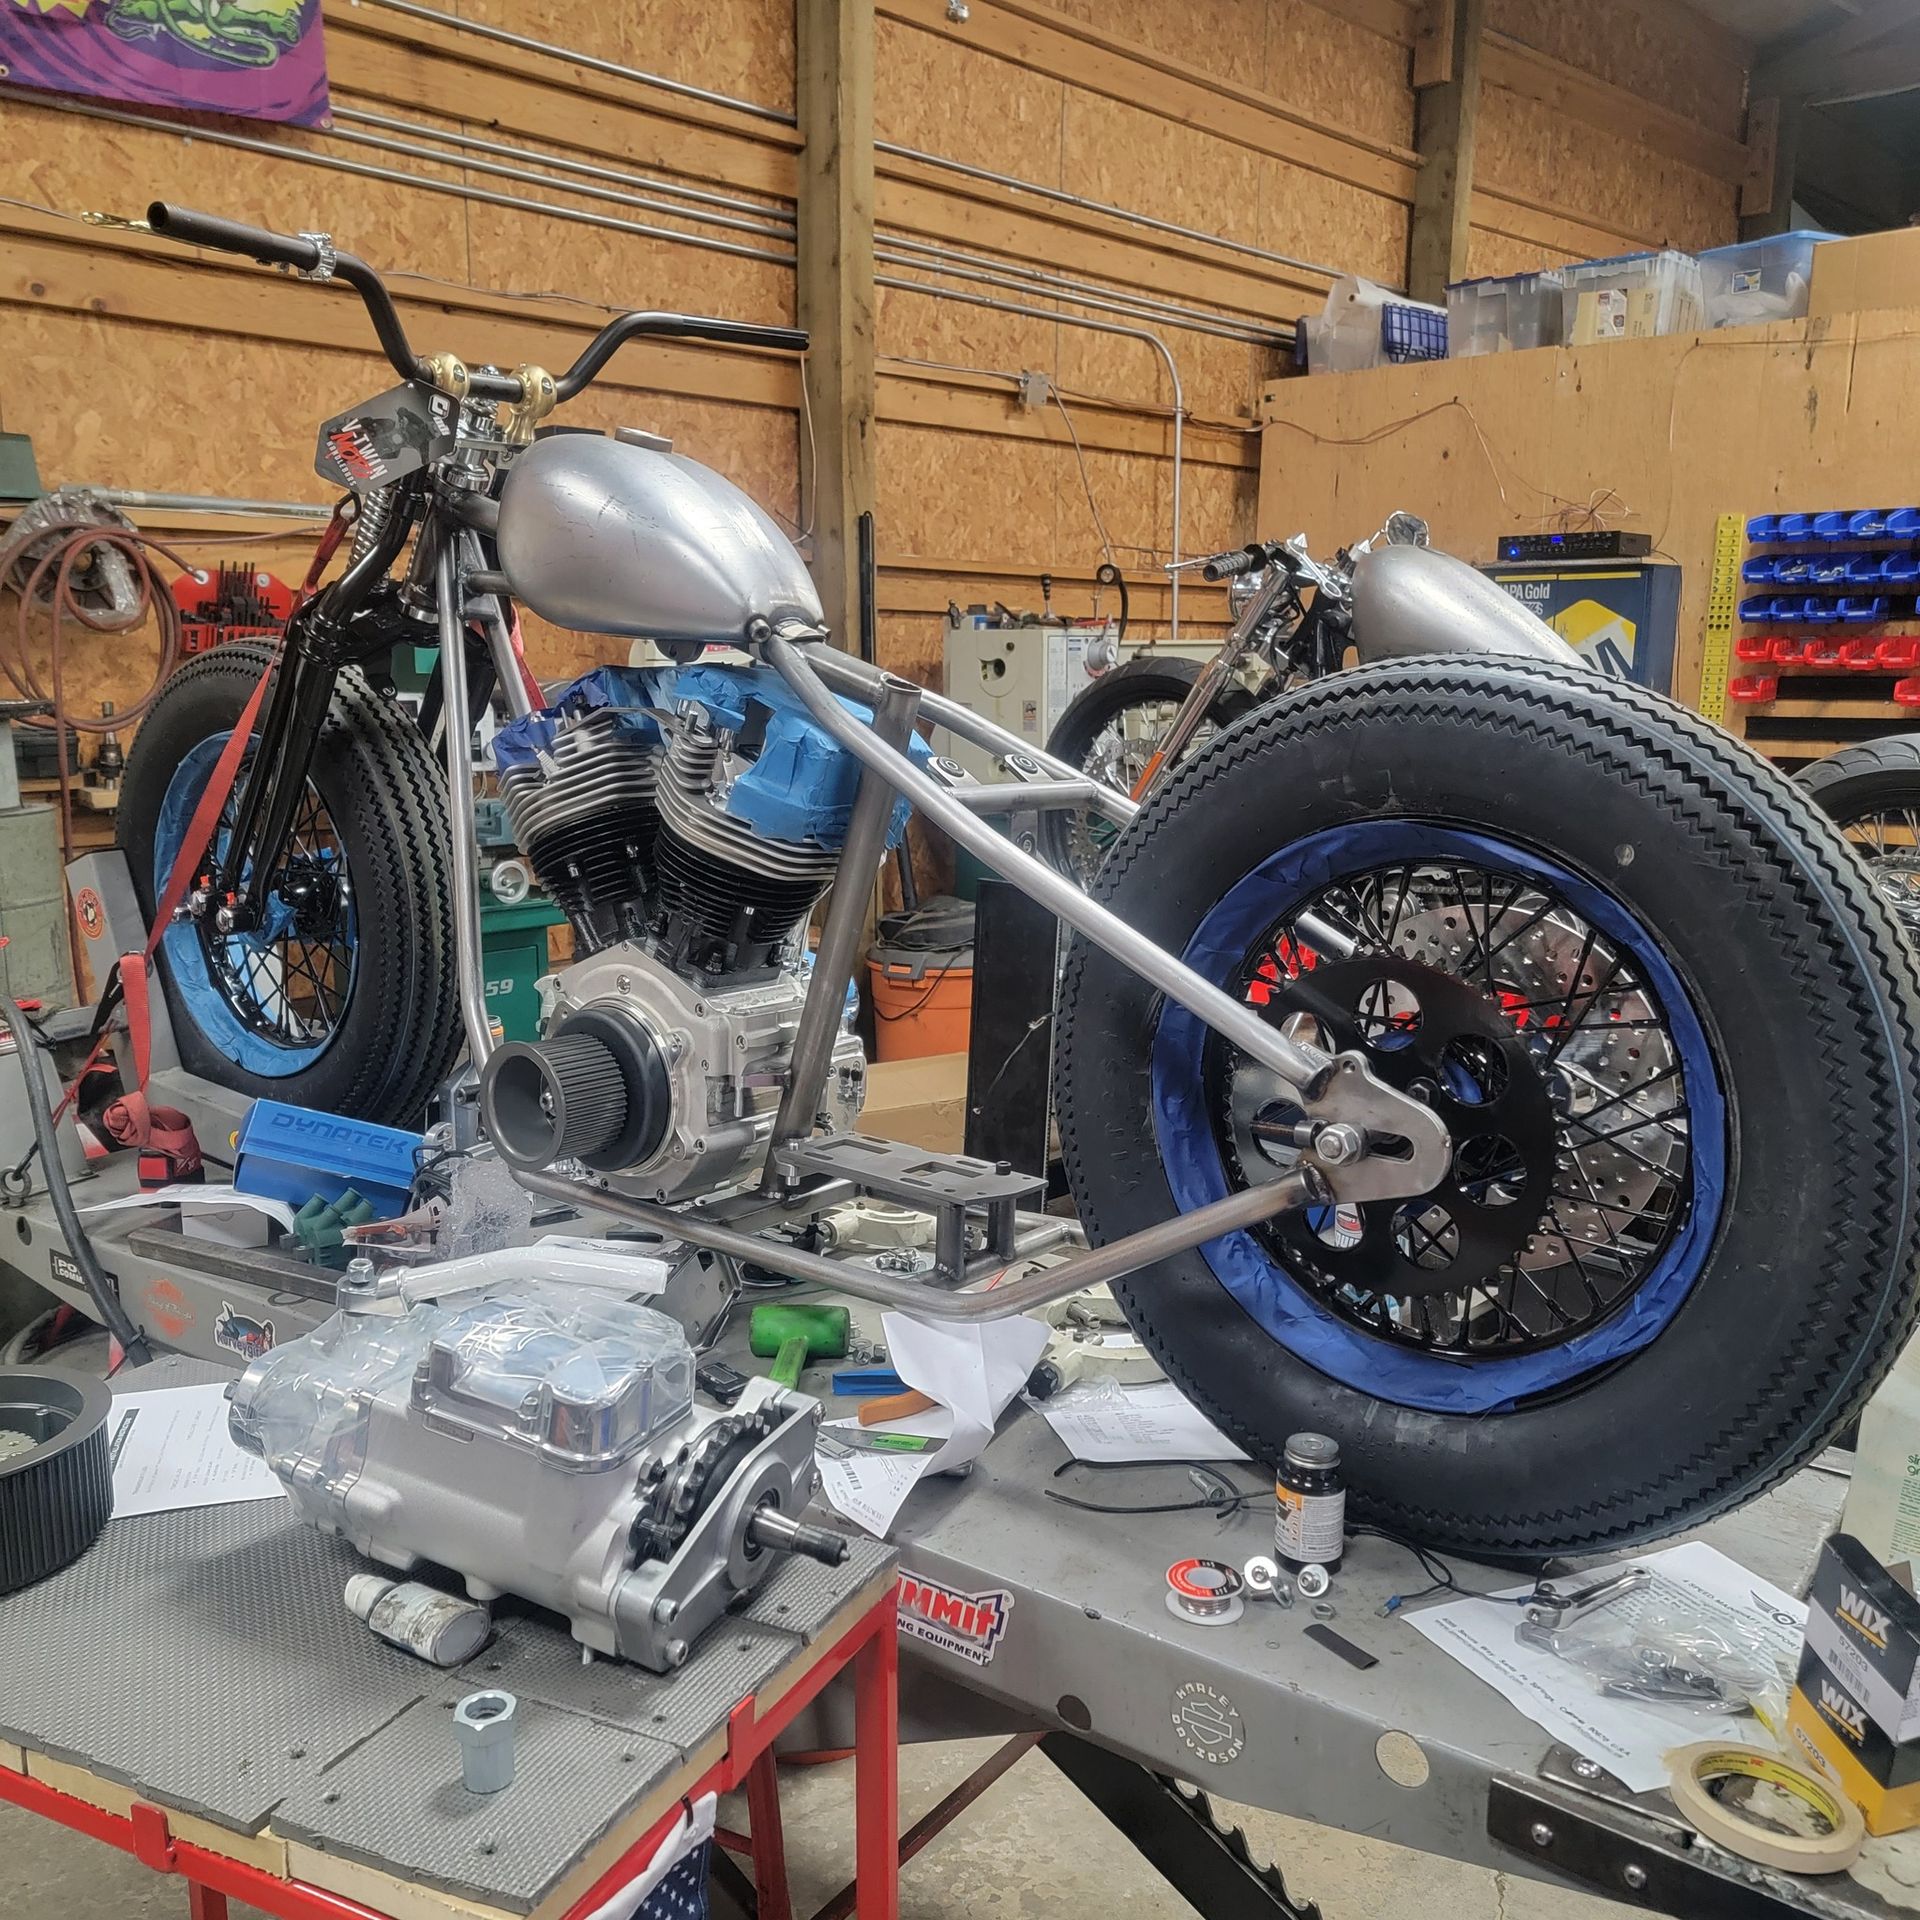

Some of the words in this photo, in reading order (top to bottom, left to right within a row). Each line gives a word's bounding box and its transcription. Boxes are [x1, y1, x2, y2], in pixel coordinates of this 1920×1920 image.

[341, 418, 388, 481] V-TWIN
[1501, 584, 1523, 599] APA
[1524, 583, 1550, 599] Gold
[271, 1112, 408, 1154] DYNATEK
[1840, 1584, 1892, 1642] WIX
[917, 1627, 990, 1664] EQUIPMENT
[1839, 1636, 1868, 1672] 57203
[1175, 1682, 1239, 1718] HARLEY
[1821, 1679, 1867, 1736] WIX
[1172, 1714, 1244, 1763] DAVIDSON
